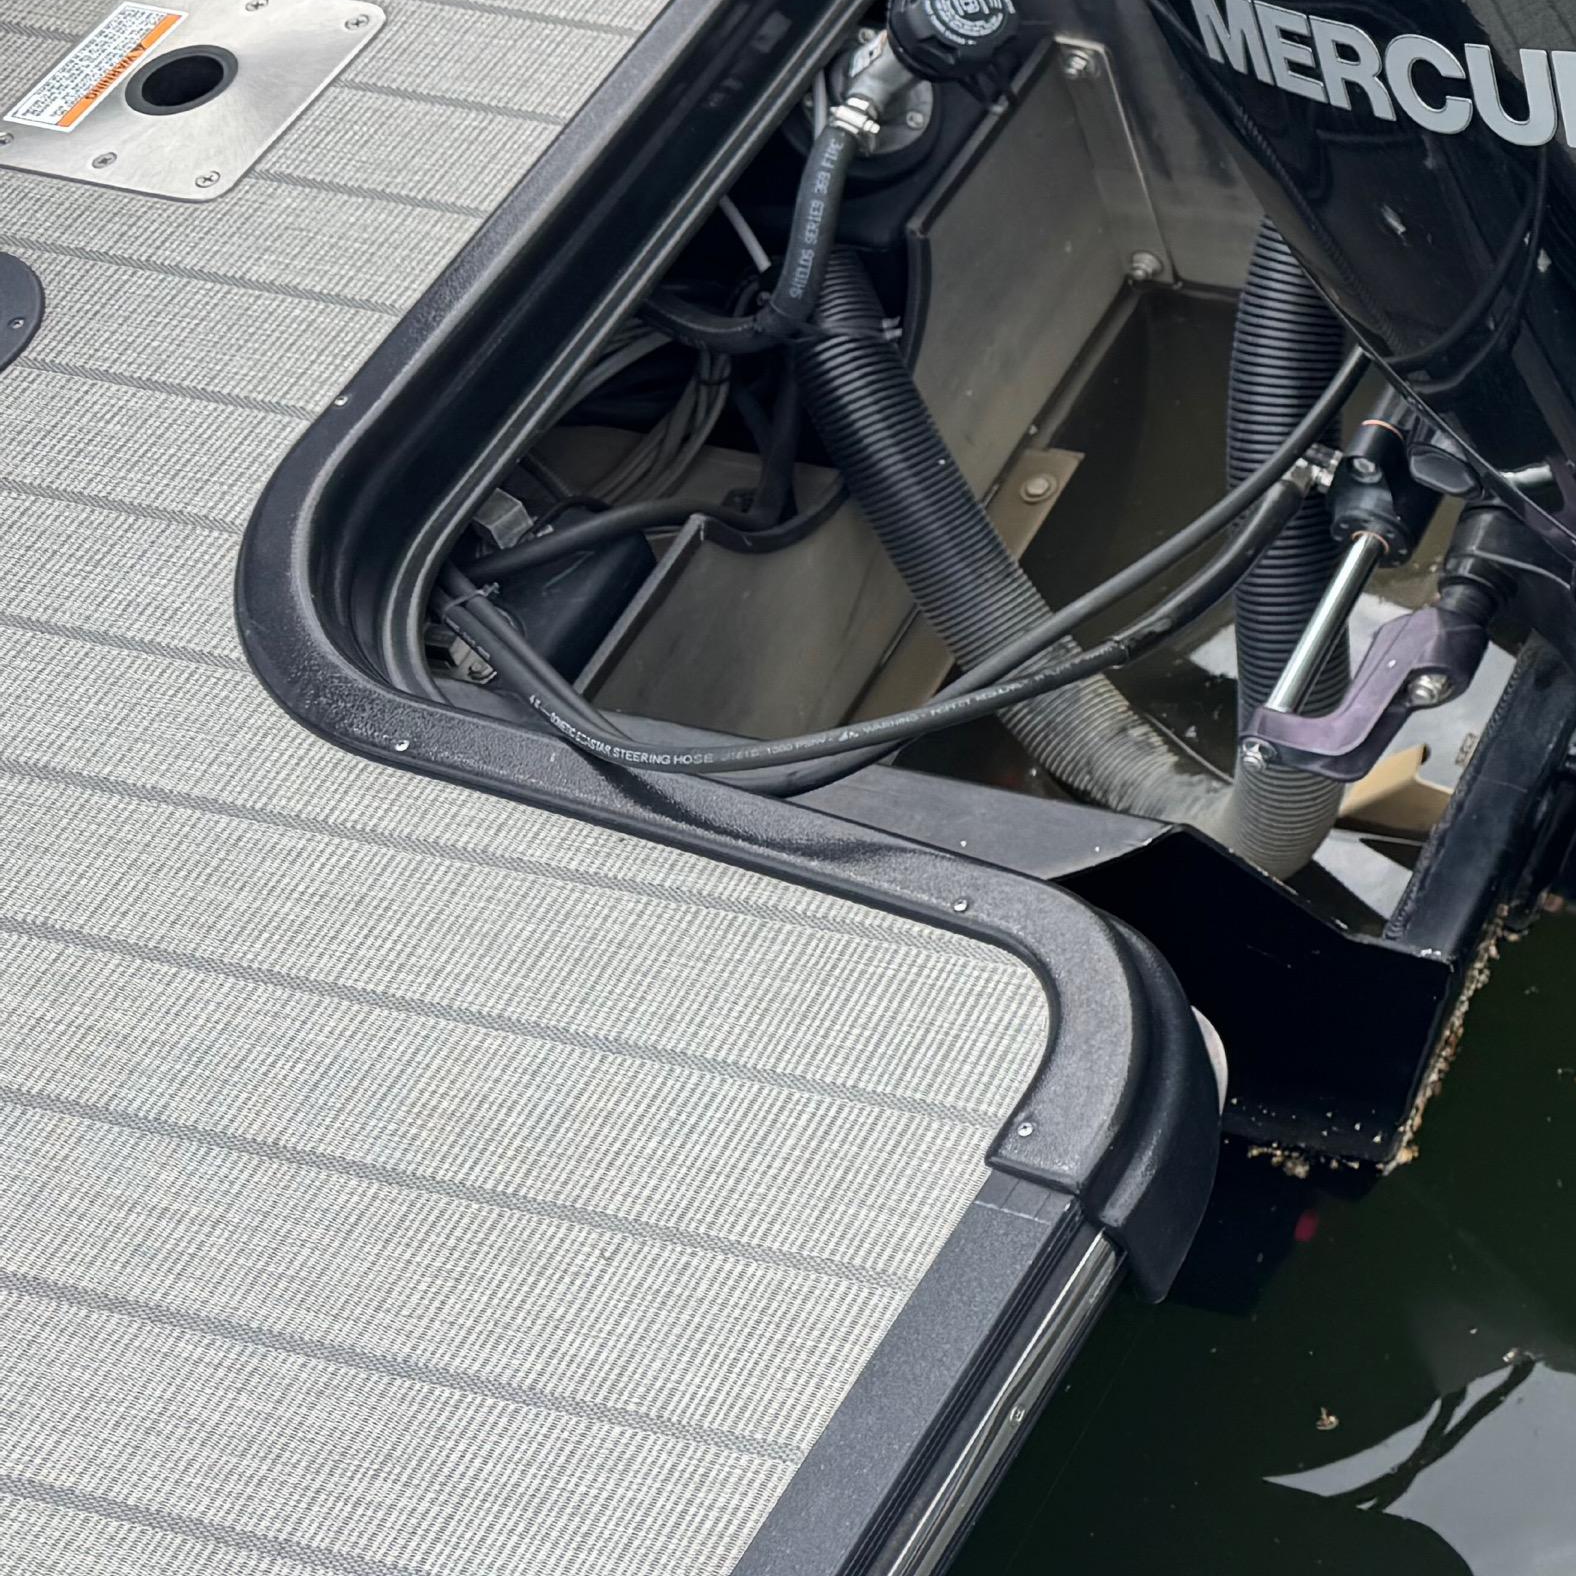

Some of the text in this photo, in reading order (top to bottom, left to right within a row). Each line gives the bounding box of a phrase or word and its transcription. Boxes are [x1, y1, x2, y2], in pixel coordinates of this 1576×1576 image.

[85, 52, 139, 100] WARNING
[613, 747, 671, 765] STEERING
[673, 752, 714, 765] HOSE
